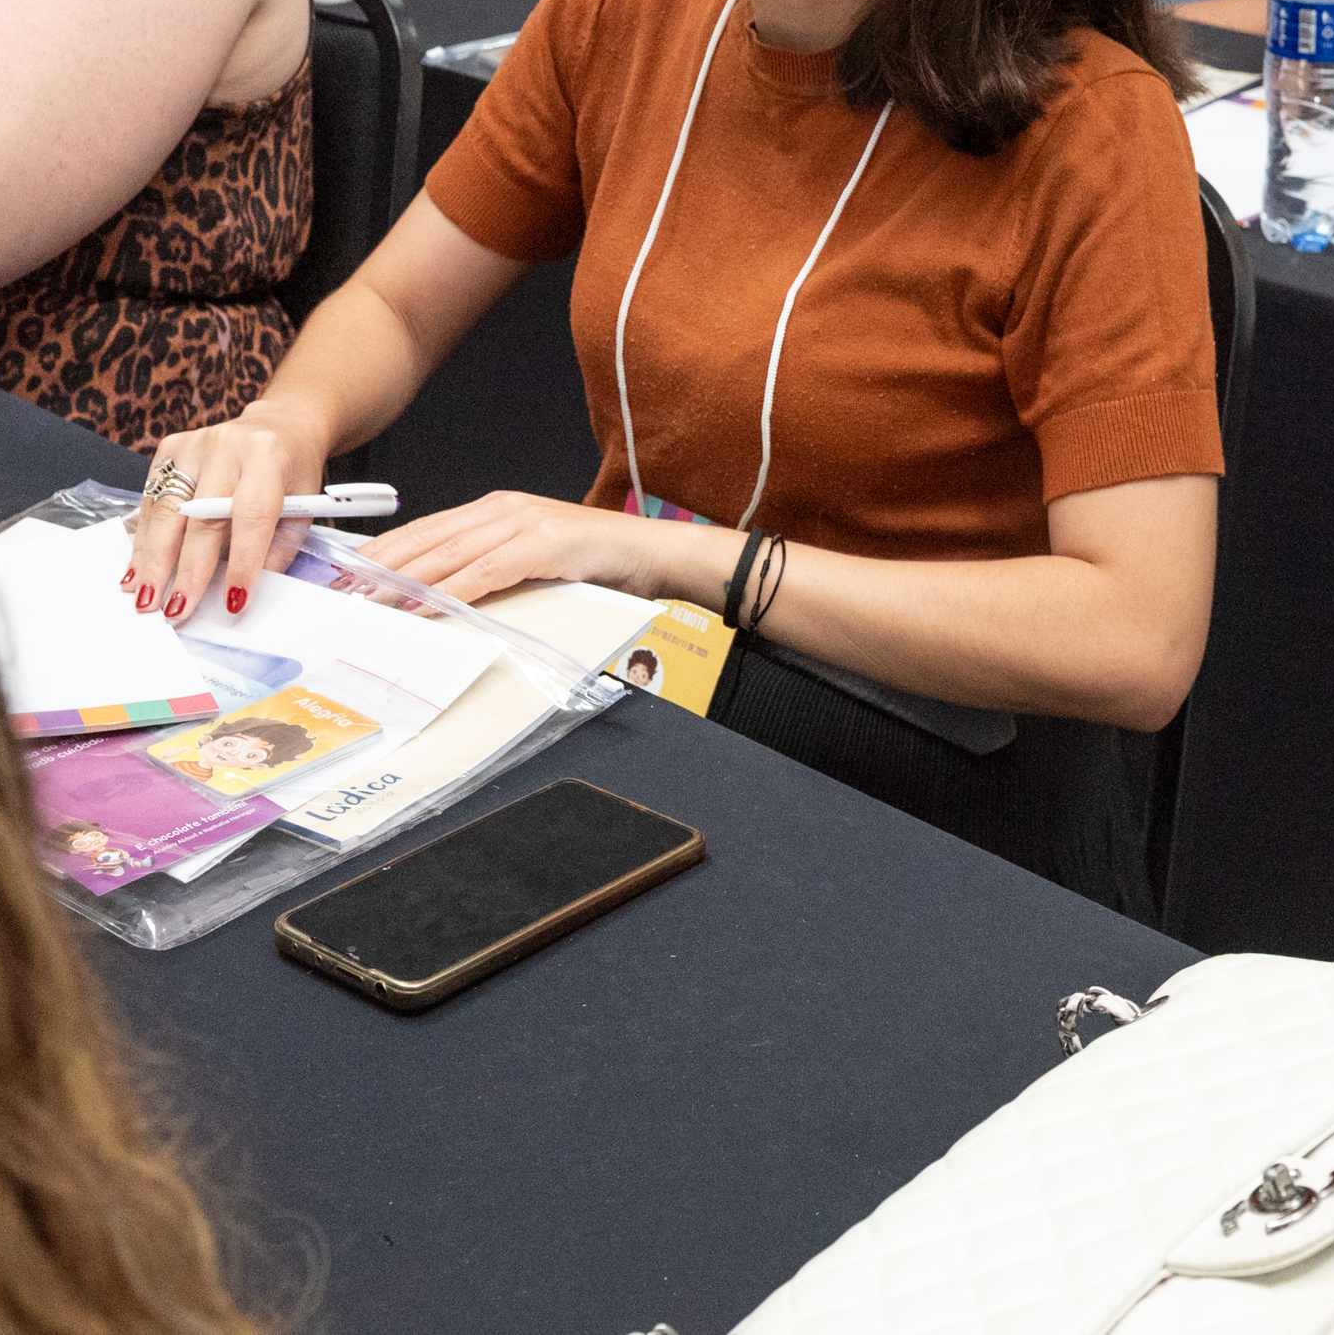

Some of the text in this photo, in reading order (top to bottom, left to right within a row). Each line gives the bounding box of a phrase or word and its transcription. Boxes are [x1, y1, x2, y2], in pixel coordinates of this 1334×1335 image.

[670, 604, 710, 633] REMOTO
[292, 697, 353, 727] Alegria
[305, 773, 402, 822] Lúdica
[147, 821, 202, 846] chocolate
